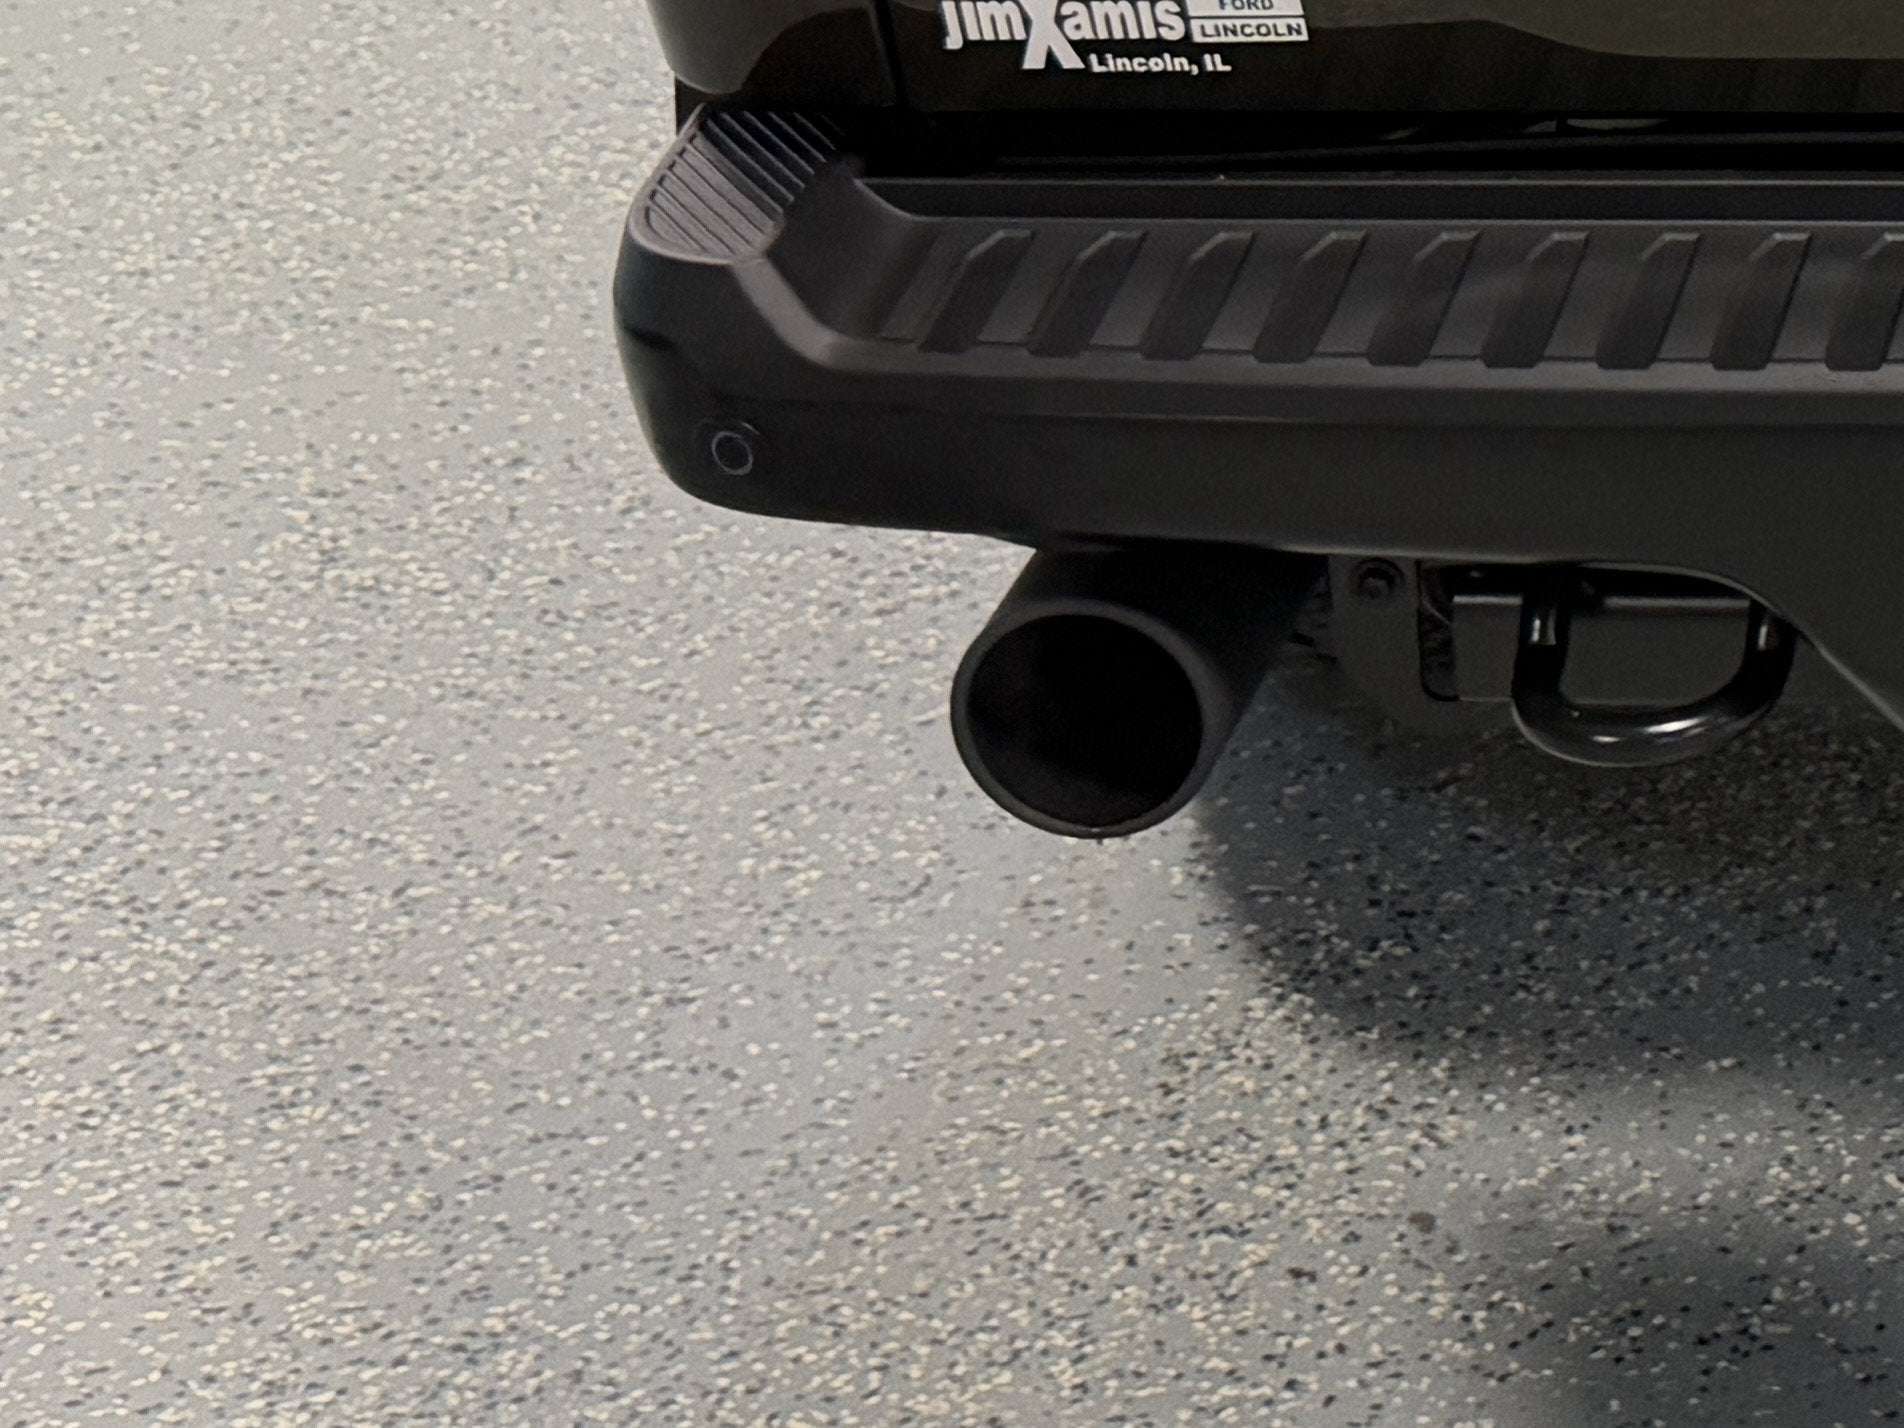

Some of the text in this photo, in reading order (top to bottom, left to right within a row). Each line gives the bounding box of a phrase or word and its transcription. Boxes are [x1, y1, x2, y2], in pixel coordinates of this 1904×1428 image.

[1200, 22, 1302, 38] LINCOLN
[1089, 53, 1232, 75] Lincoln, IL
